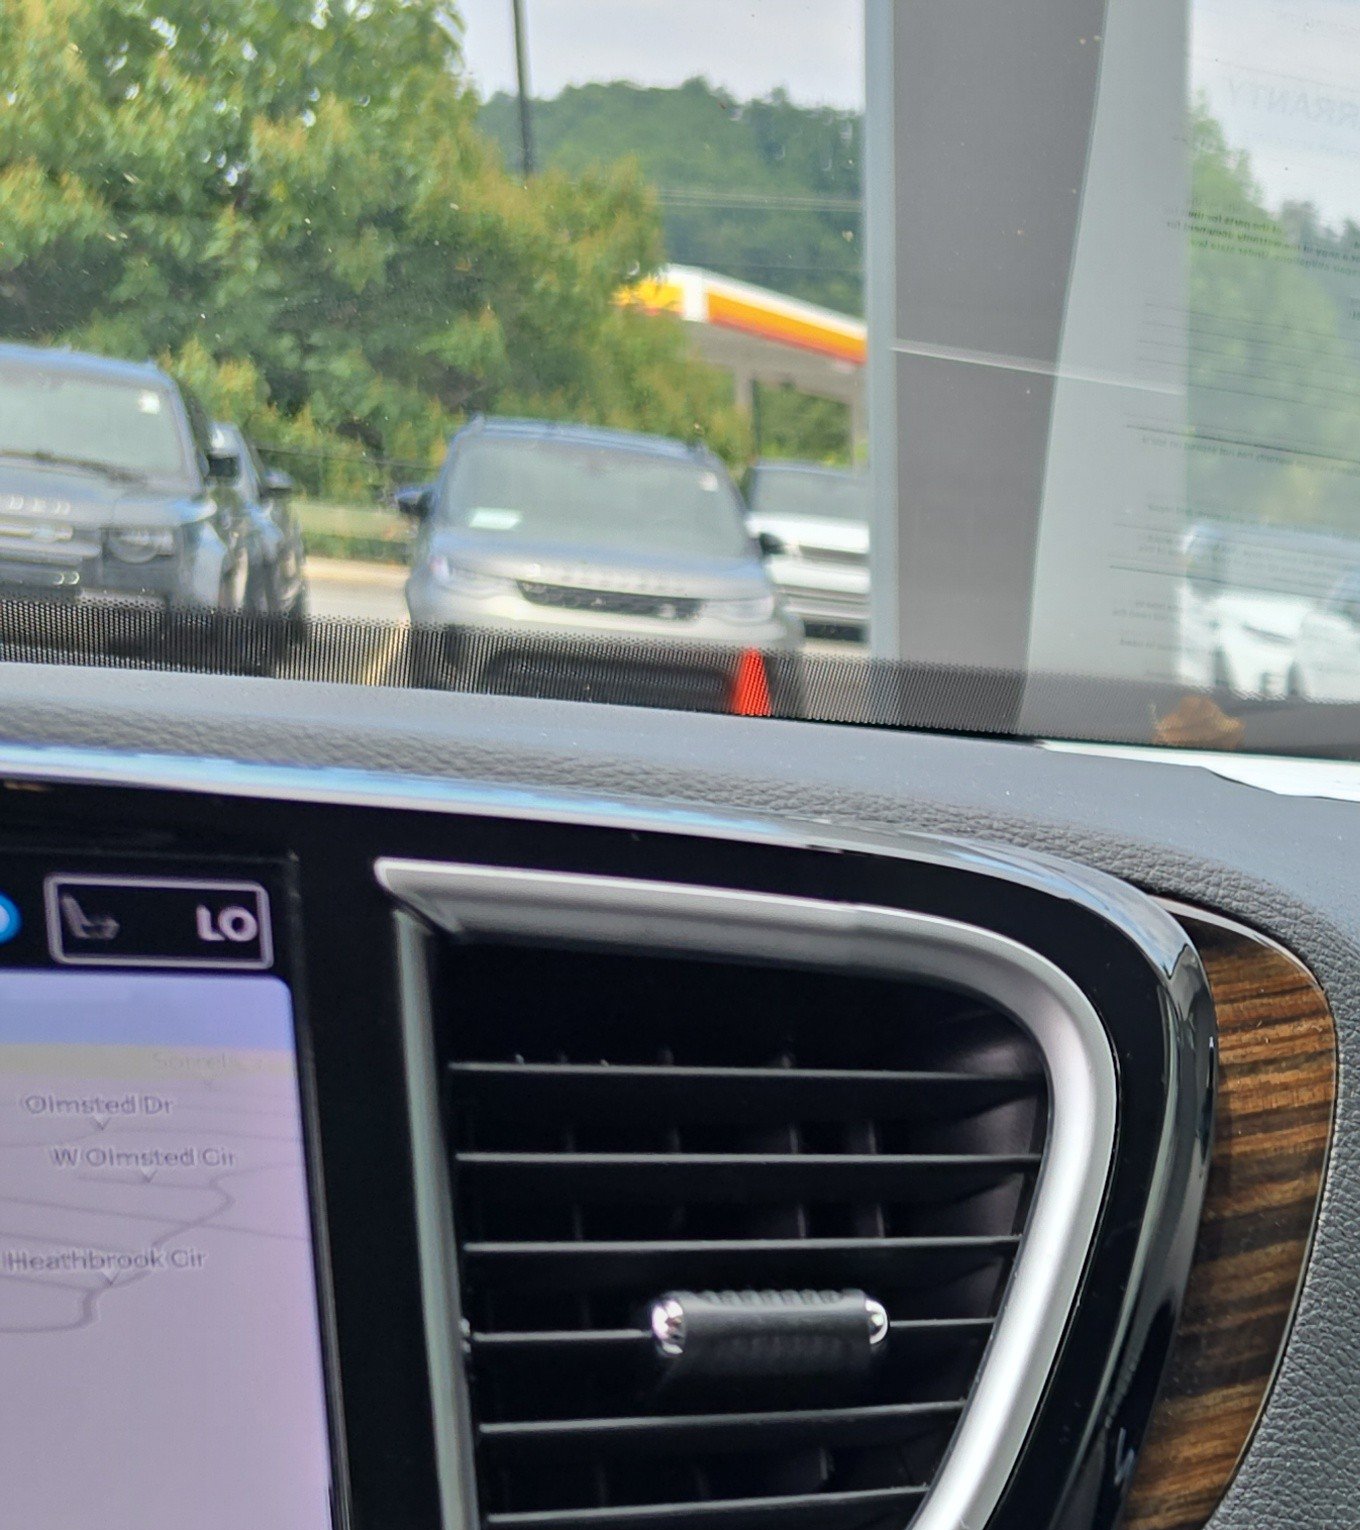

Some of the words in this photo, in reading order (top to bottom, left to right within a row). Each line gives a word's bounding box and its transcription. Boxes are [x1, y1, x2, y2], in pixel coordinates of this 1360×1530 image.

[194, 904, 259, 943] LO
[25, 1095, 135, 1115] Olmsted
[143, 1095, 172, 1115] Dr
[53, 1148, 78, 1167] W
[85, 1147, 196, 1167] Olmsted
[202, 1147, 235, 1167] Cir
[5, 1250, 164, 1271] Heathbrook
[171, 1250, 207, 1270] Cir
